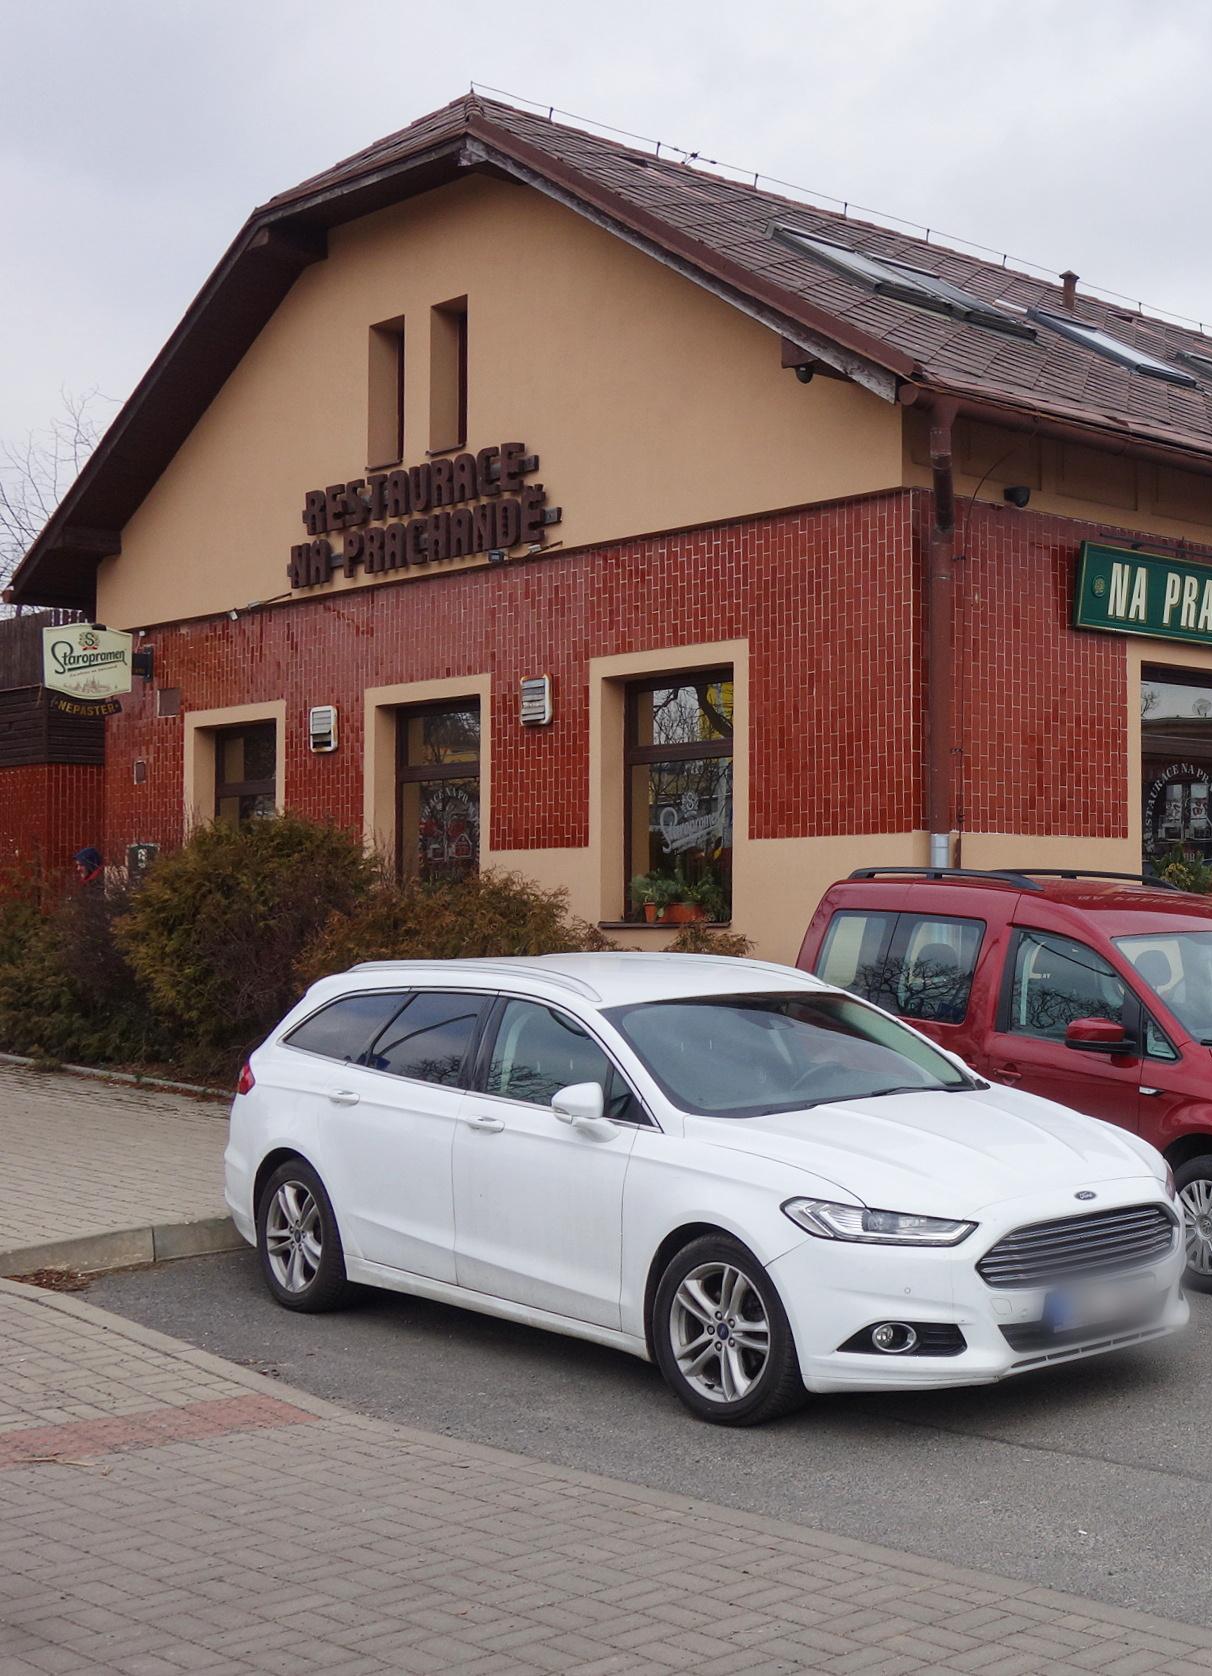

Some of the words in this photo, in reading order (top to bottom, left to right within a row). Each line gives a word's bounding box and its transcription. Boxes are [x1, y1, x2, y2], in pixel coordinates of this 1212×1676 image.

[305, 443, 525, 535] RESTAURACE
[290, 539, 331, 589] NA
[1108, 563, 1148, 621] NA
[51, 641, 127, 674] Staropramen
[57, 700, 114, 716] NEPASTER
[1181, 762, 1195, 775] NA
